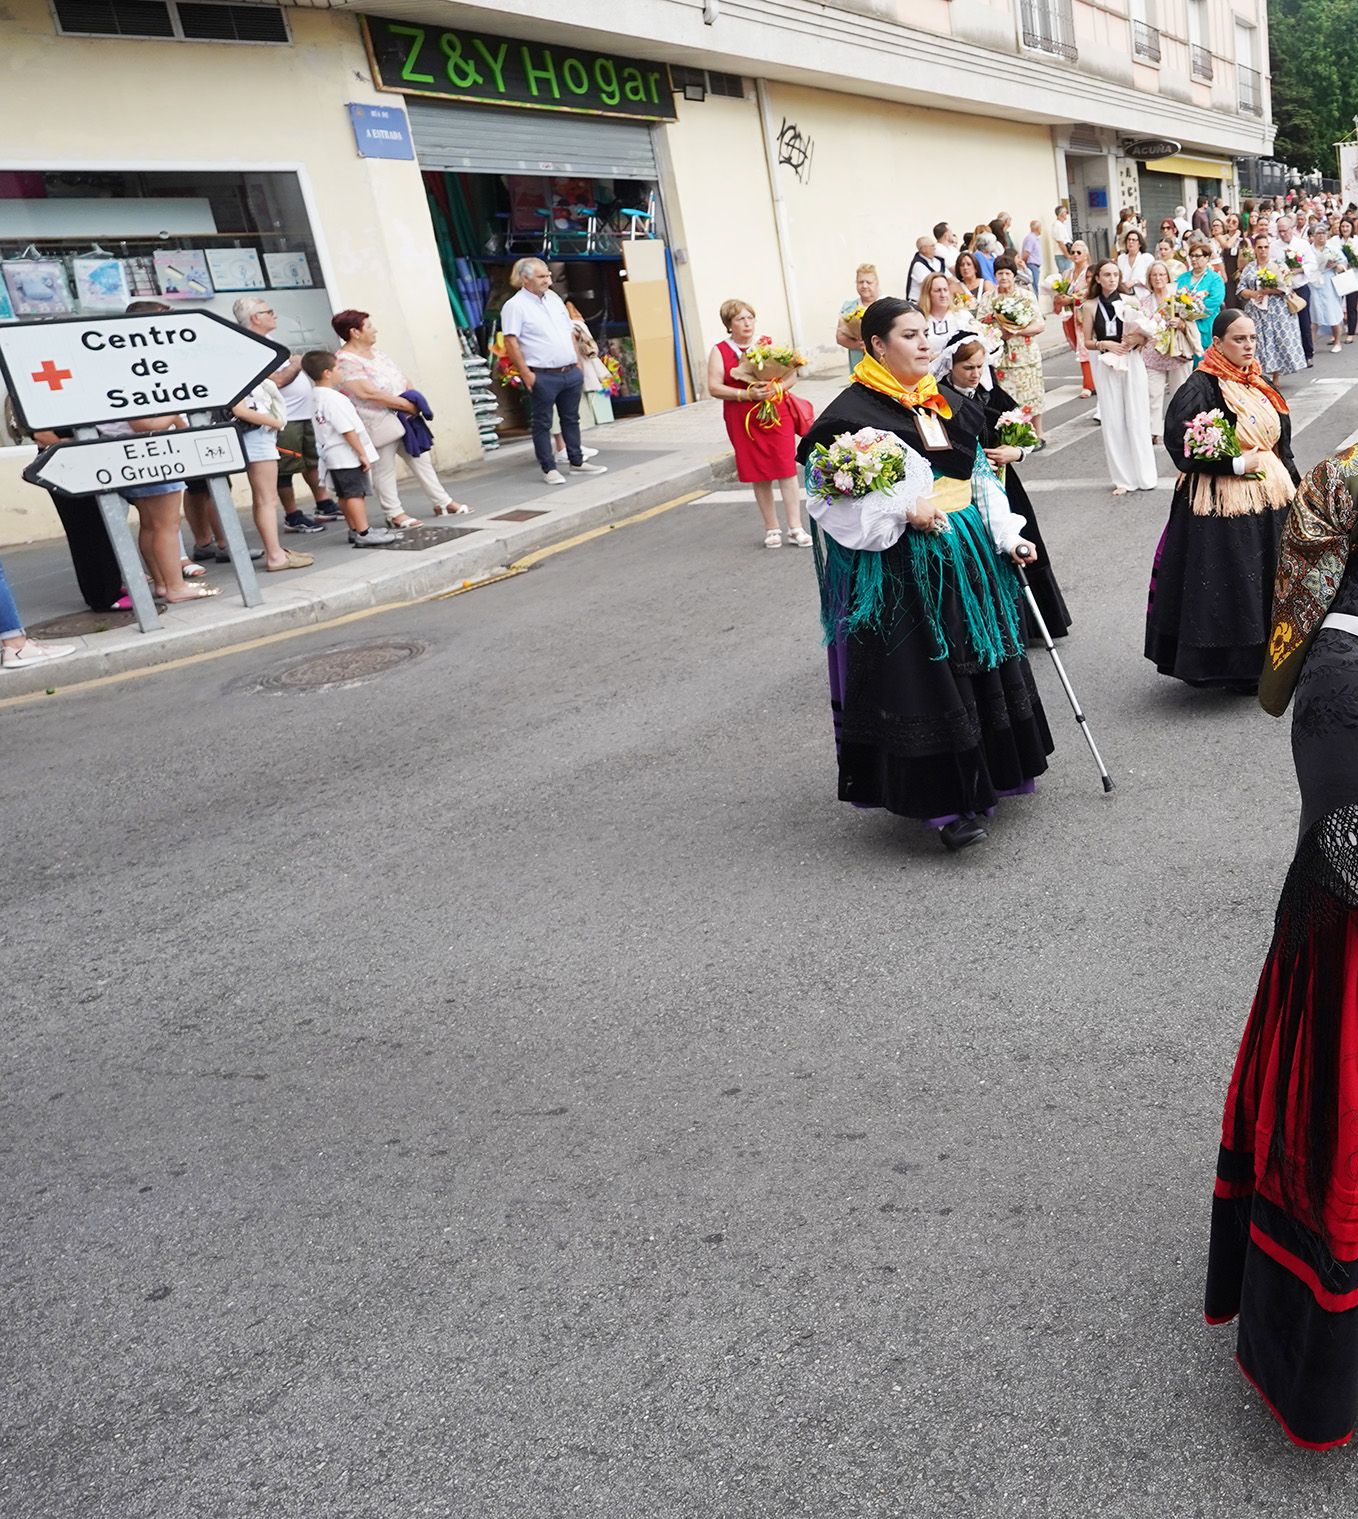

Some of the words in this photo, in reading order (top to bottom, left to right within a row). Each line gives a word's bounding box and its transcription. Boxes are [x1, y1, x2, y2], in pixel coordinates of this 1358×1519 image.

[520, 45, 661, 106] Hogar
[1132, 143, 1173, 155] ACUÑA
[81, 326, 197, 351] Centro
[131, 358, 169, 377] de
[106, 382, 208, 408] Saúde
[123, 439, 181, 460] E.E.I.
[96, 468, 112, 485] O
[120, 462, 186, 481] Grupo
